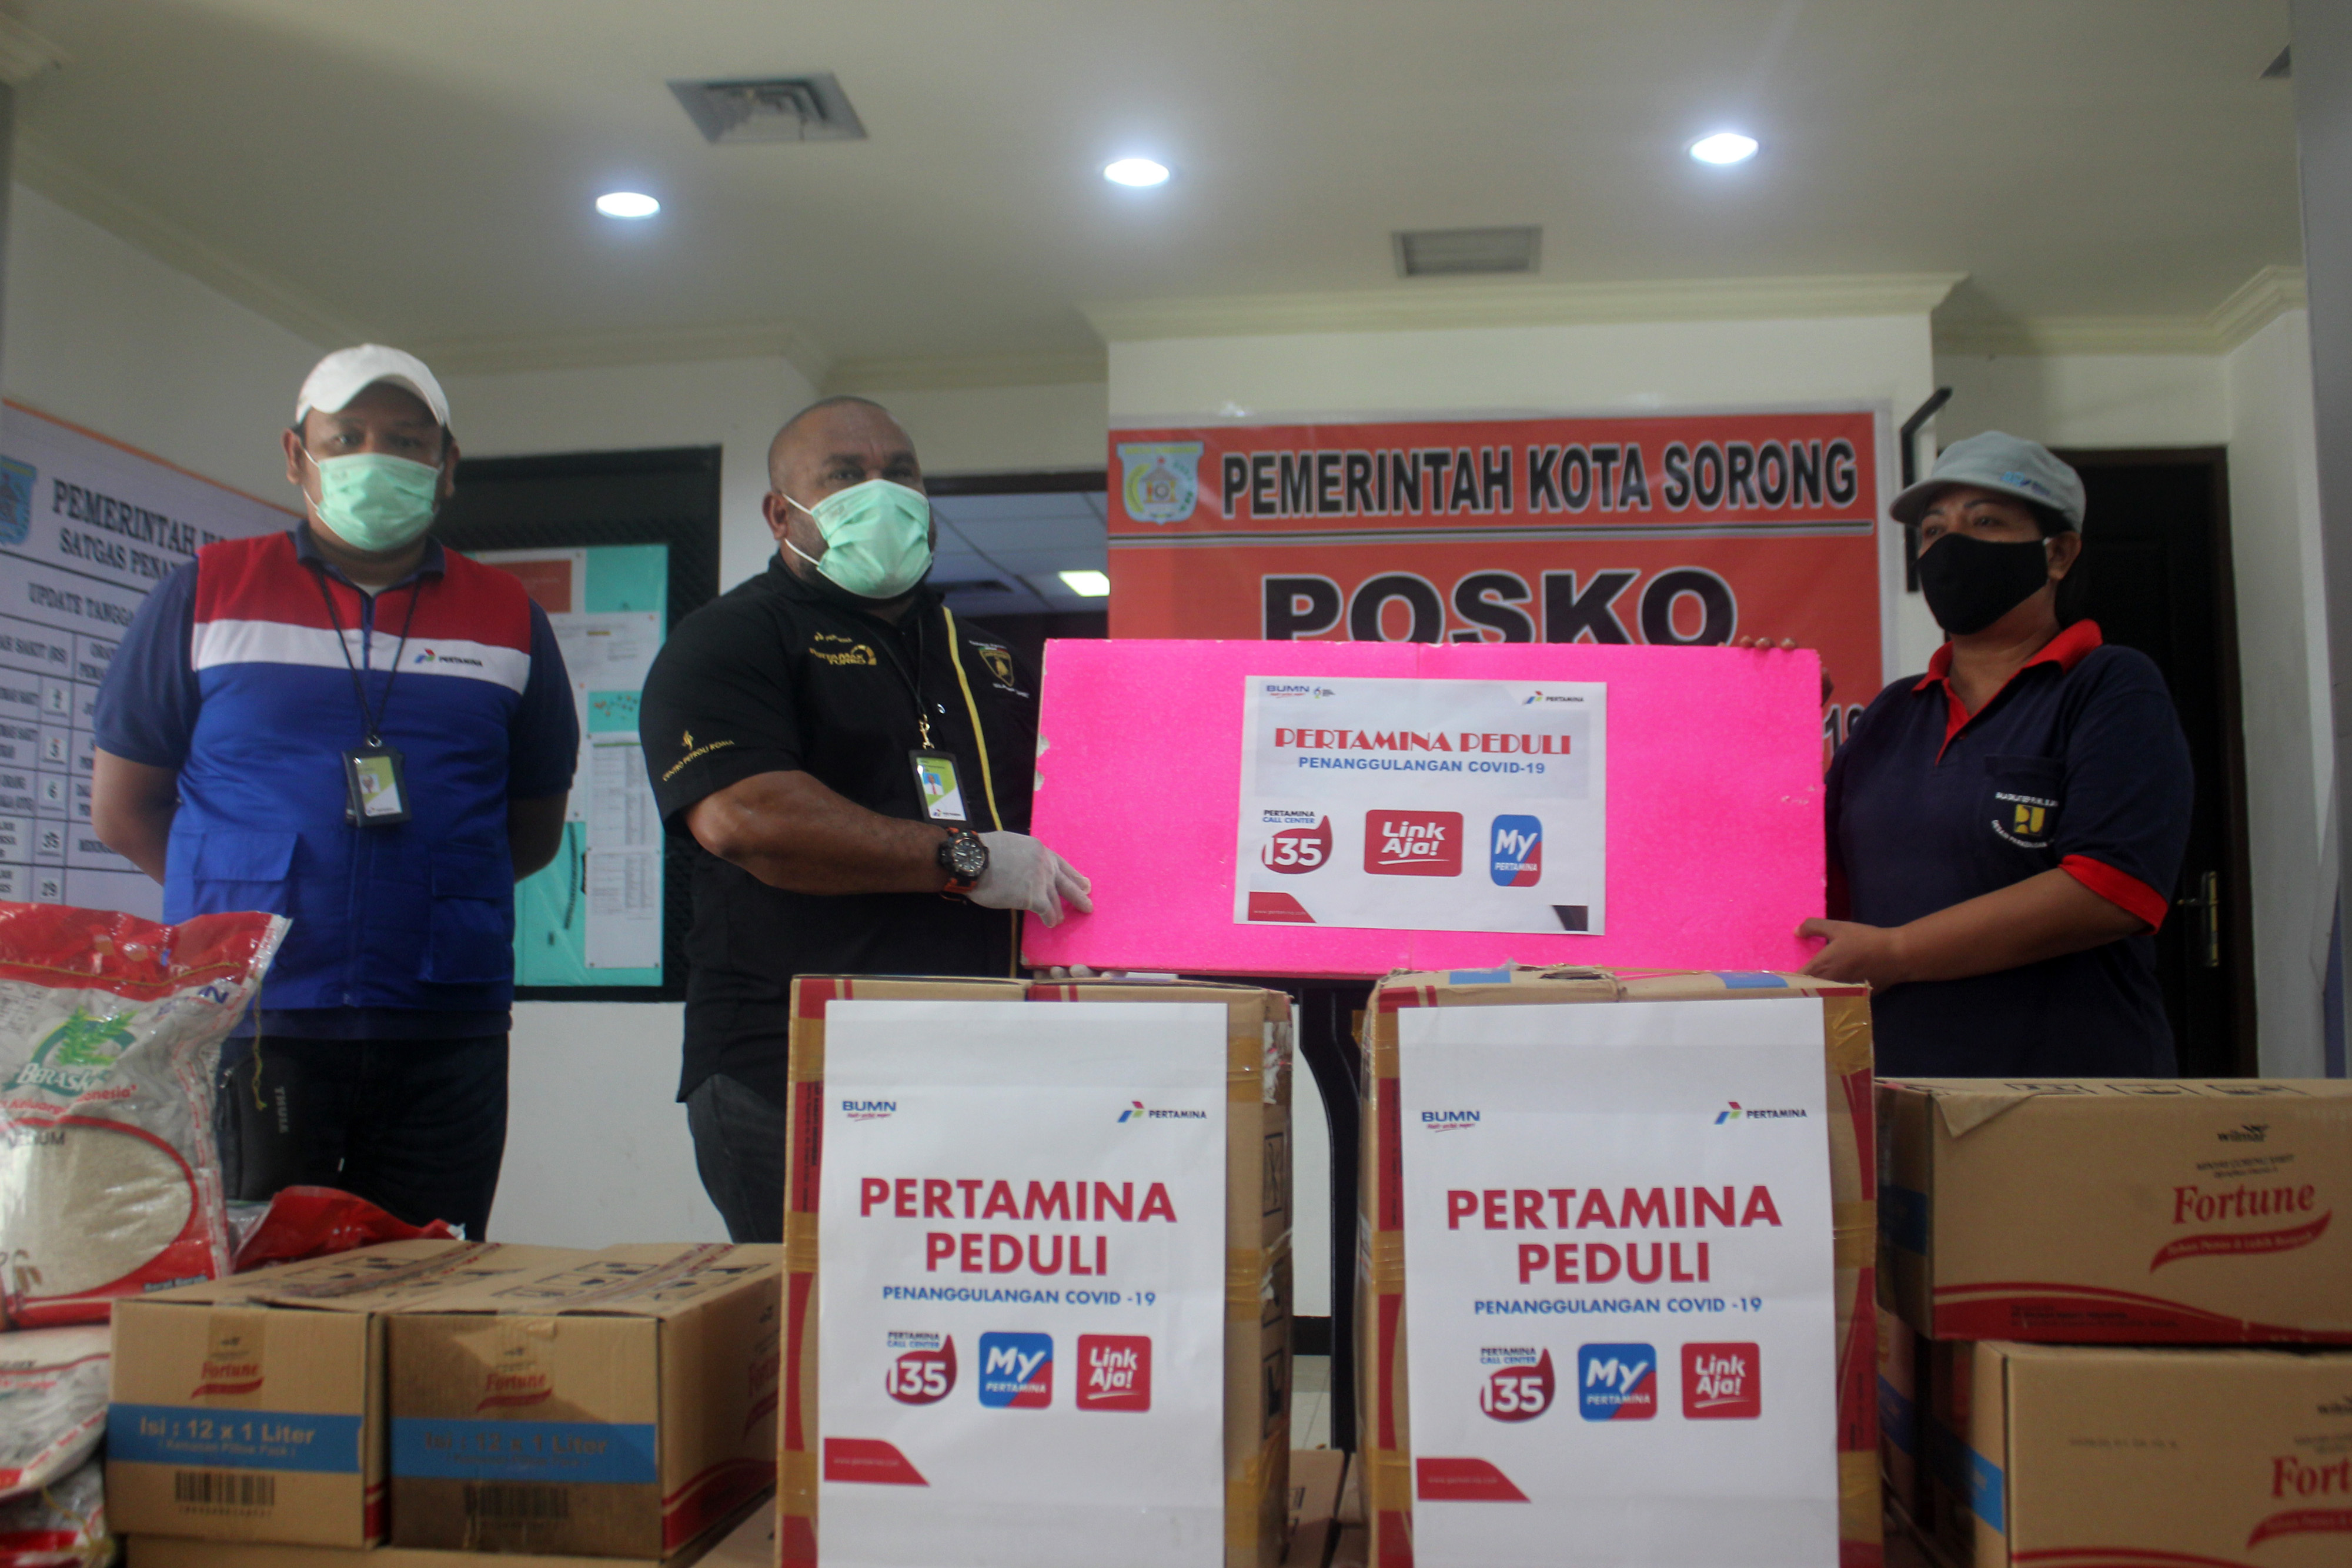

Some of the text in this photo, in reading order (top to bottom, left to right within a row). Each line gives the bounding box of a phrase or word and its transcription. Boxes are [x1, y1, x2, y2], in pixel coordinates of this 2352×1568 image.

[1222, 438, 1859, 519] PEMERINTAH KOTA SORONG
[52, 477, 197, 557] PEMERINTAH
[59, 527, 126, 571] SATGAS
[1262, 566, 1738, 647] POSKO
[1275, 728, 1571, 755] PERTAMINA PEDULI
[1299, 757, 1545, 774] PENANGGULANGAN COVID-19
[1382, 821, 1446, 841] Link
[1264, 837, 1322, 867] 135
[1381, 838, 1440, 858] Aja!
[1494, 829, 1538, 862] My
[1494, 862, 1538, 872] PERTAMINA
[843, 1101, 897, 1112] BUMN
[1149, 1109, 1207, 1119] PERTAMINA
[1422, 1111, 1479, 1122] BUMN
[1746, 1109, 1807, 1118] PERTAMINA
[860, 1177, 1177, 1223] PERTAMINA
[1447, 1185, 1782, 1230] PERTAMINA
[2171, 1183, 2315, 1225] Fortune
[926, 1232, 1108, 1276] PEDULI
[1518, 1242, 1709, 1284] PEDULI
[883, 1286, 1156, 1306] PENANGGULANGAN COVID -19
[1474, 1297, 1762, 1314] PENANGGULANGAN COVID -19
[888, 1332, 940, 1340] PERTAMINA
[1089, 1346, 1138, 1370] Link
[1481, 1348, 1536, 1356] PERTAMINA
[201, 1360, 259, 1380] Fortune
[985, 1346, 1046, 1383] My
[1585, 1357, 1649, 1394] My
[1695, 1354, 1746, 1378] Link
[485, 1373, 546, 1392] Fortune
[888, 1361, 948, 1397] 135
[985, 1382, 1047, 1394] PERTAMINA
[1089, 1366, 1134, 1392] Aja!
[1695, 1375, 1742, 1399] Aja!
[1484, 1377, 1545, 1413] 135
[1586, 1392, 1651, 1405] PERTAMINA
[140, 1416, 166, 1437] Isi
[186, 1418, 214, 1439] 12
[220, 1425, 234, 1440] x
[241, 1422, 253, 1441] 1
[262, 1423, 317, 1445] Liter
[424, 1431, 453, 1450] Isi
[475, 1432, 502, 1452] 12
[509, 1438, 522, 1452] x
[532, 1433, 543, 1452] 1
[551, 1435, 608, 1455] Liter
